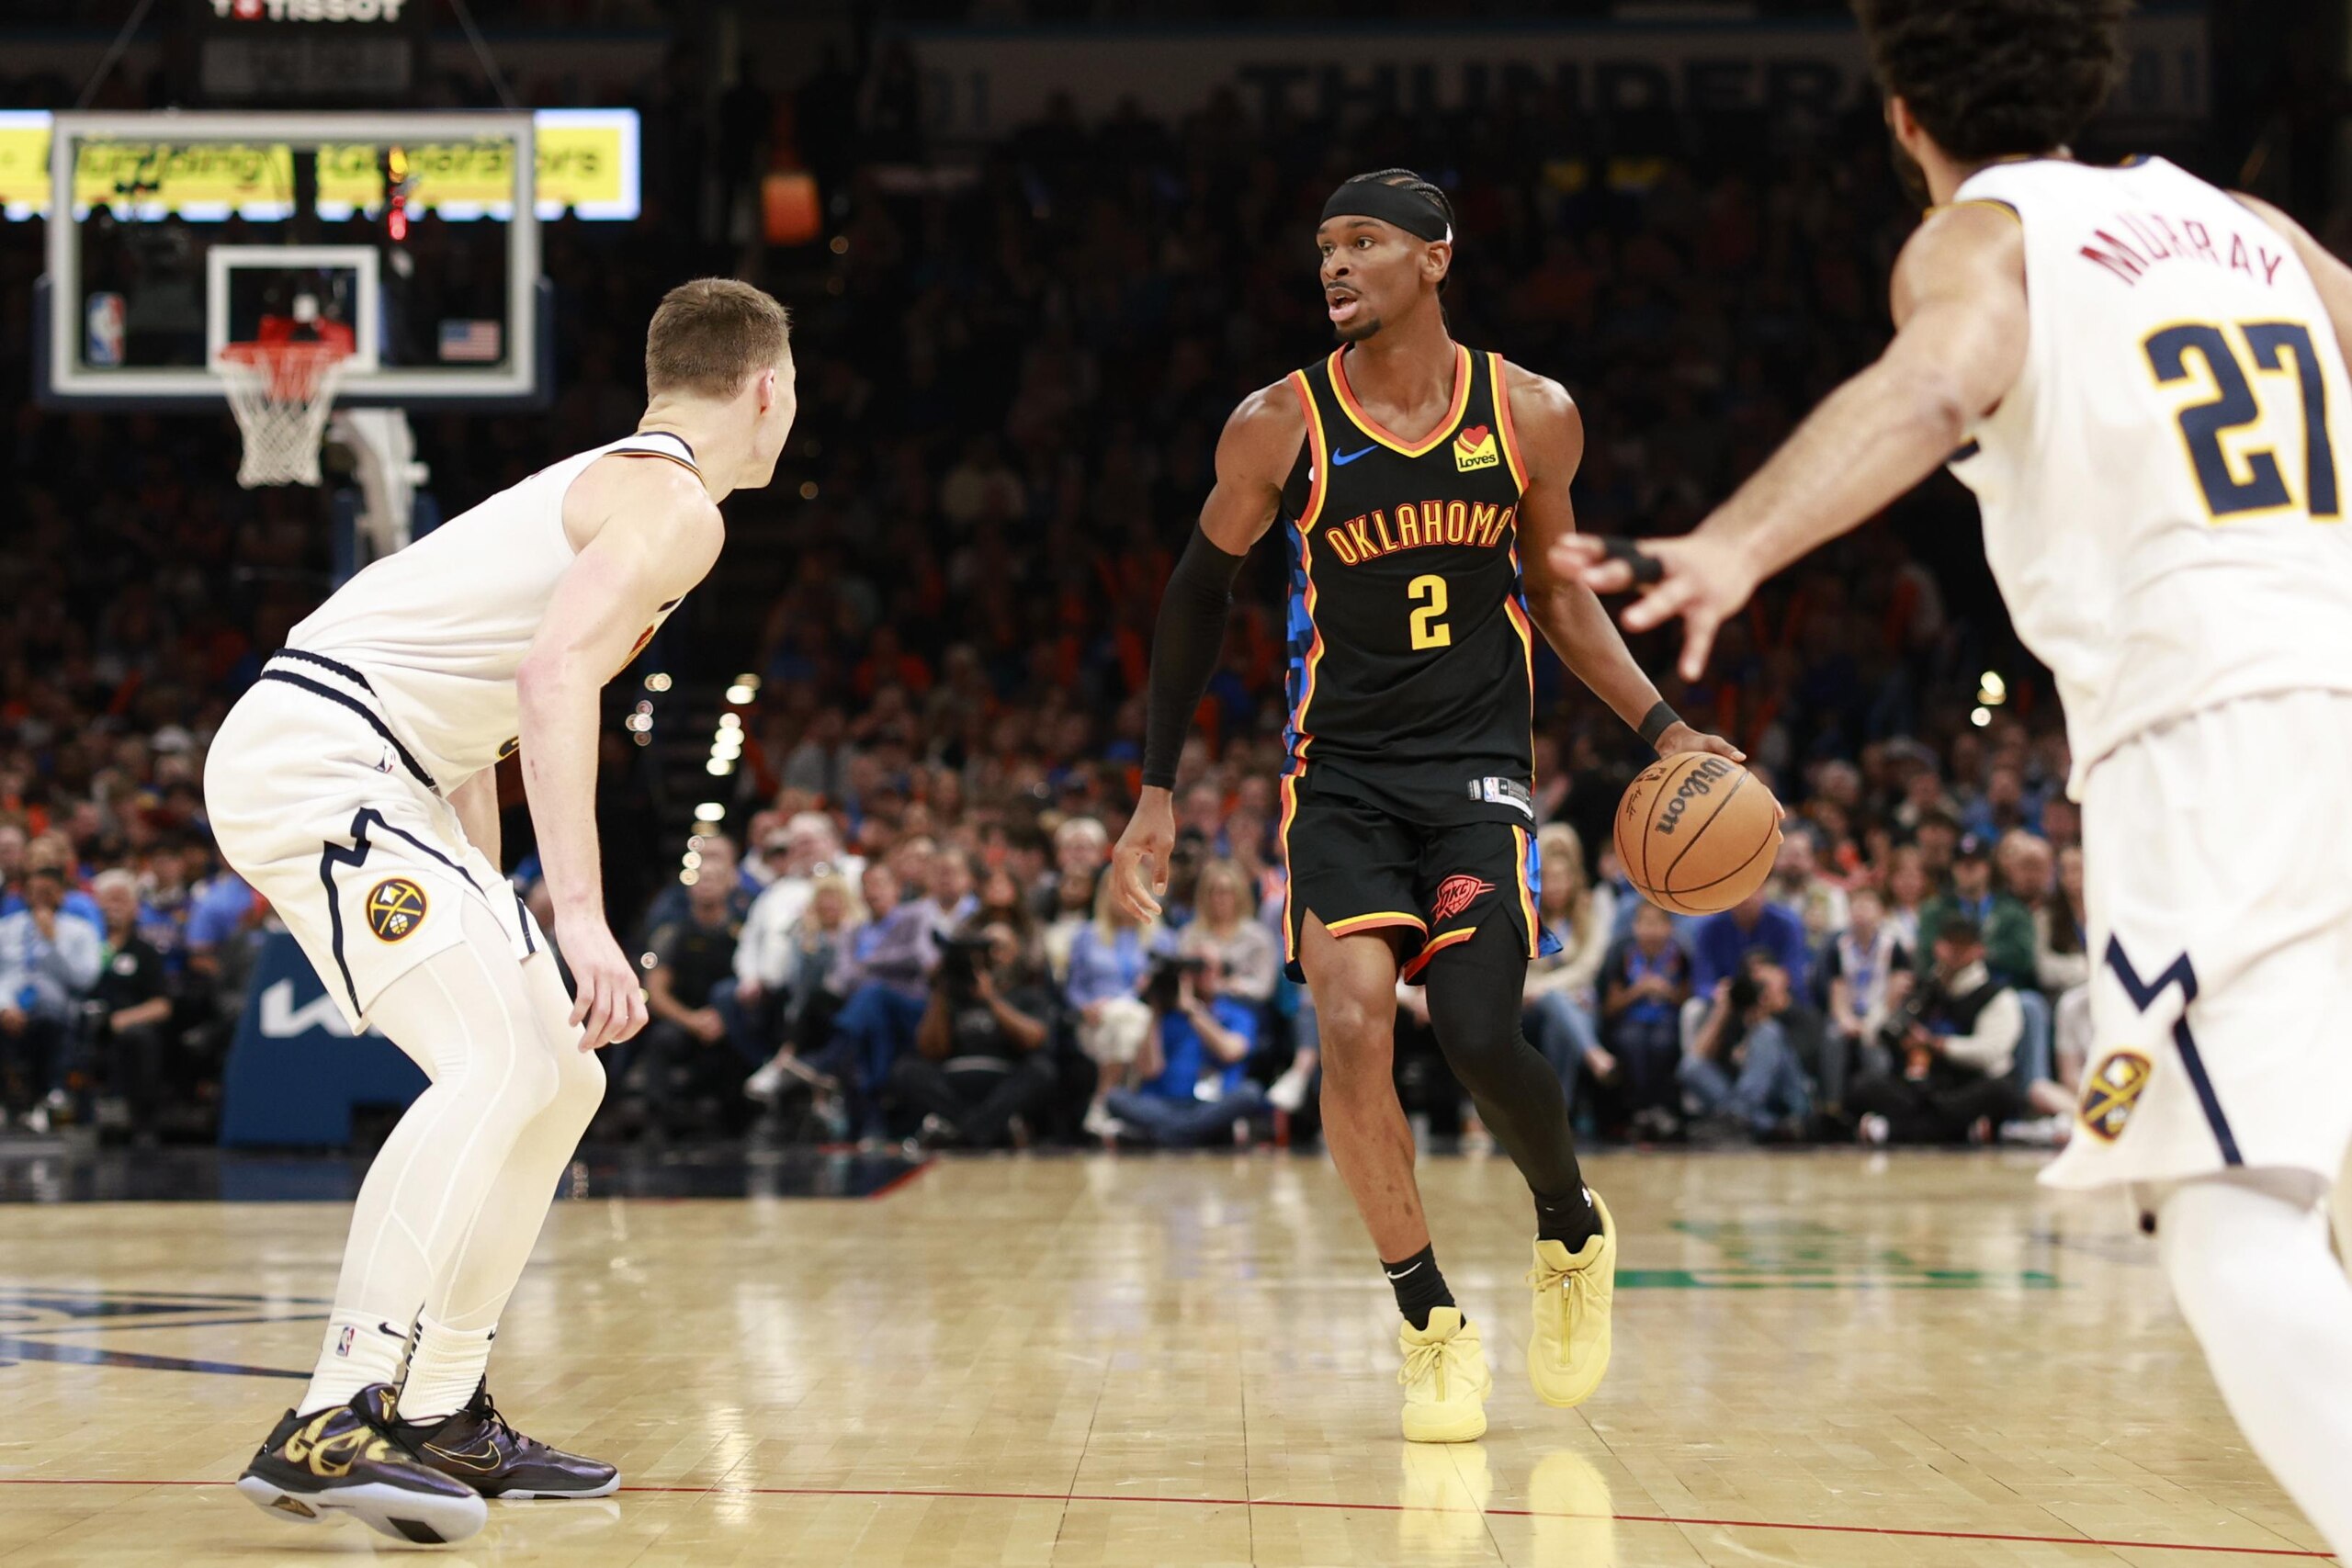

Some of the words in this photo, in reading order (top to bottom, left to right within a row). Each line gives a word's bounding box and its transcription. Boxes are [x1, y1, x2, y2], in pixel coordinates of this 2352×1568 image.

[2078, 211, 2284, 288] MURRAY
[2140, 318, 2344, 525] 27
[1325, 500, 1514, 566] OKLAHOMA
[1408, 574, 1451, 650] 2
[1656, 758, 1736, 835] Wilson
